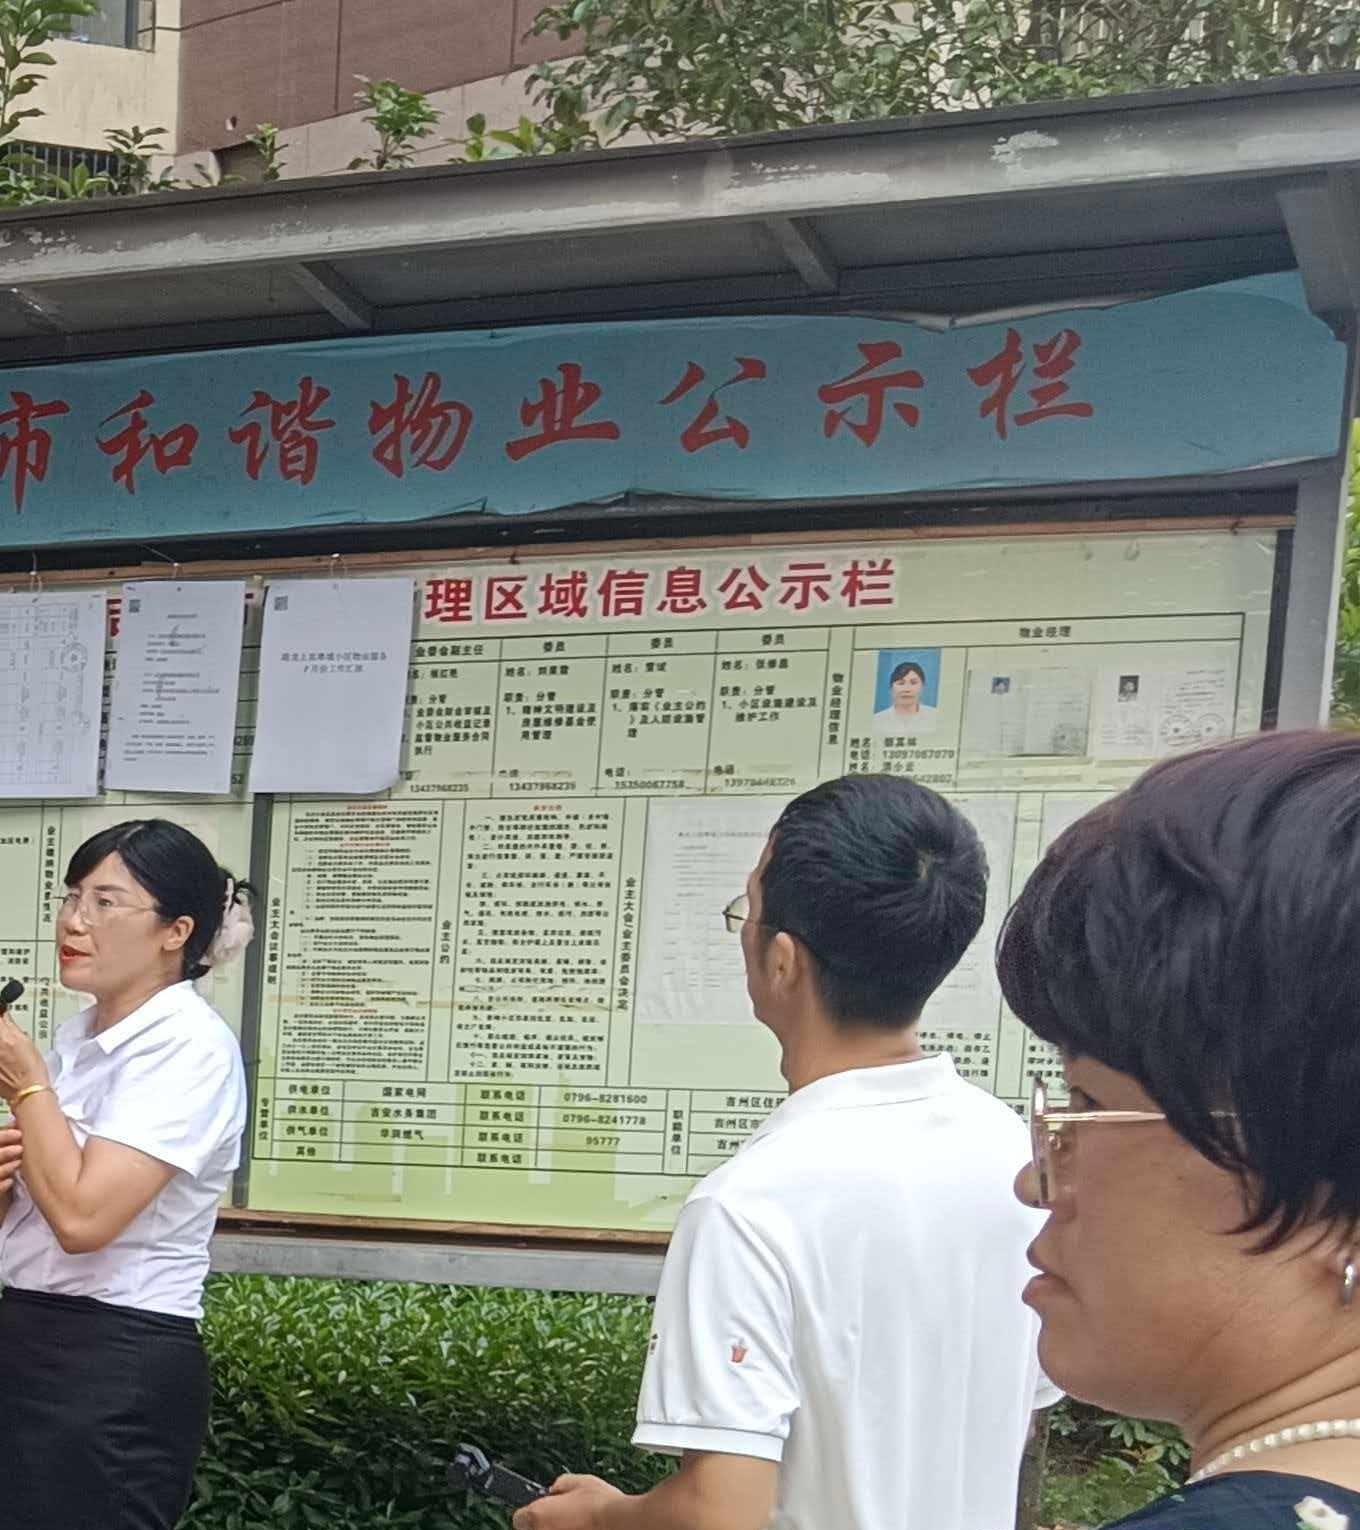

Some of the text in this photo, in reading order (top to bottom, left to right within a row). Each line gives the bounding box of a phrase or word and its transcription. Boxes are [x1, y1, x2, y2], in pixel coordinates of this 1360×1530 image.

[424, 557, 896, 623] 理区域信息公示栏
